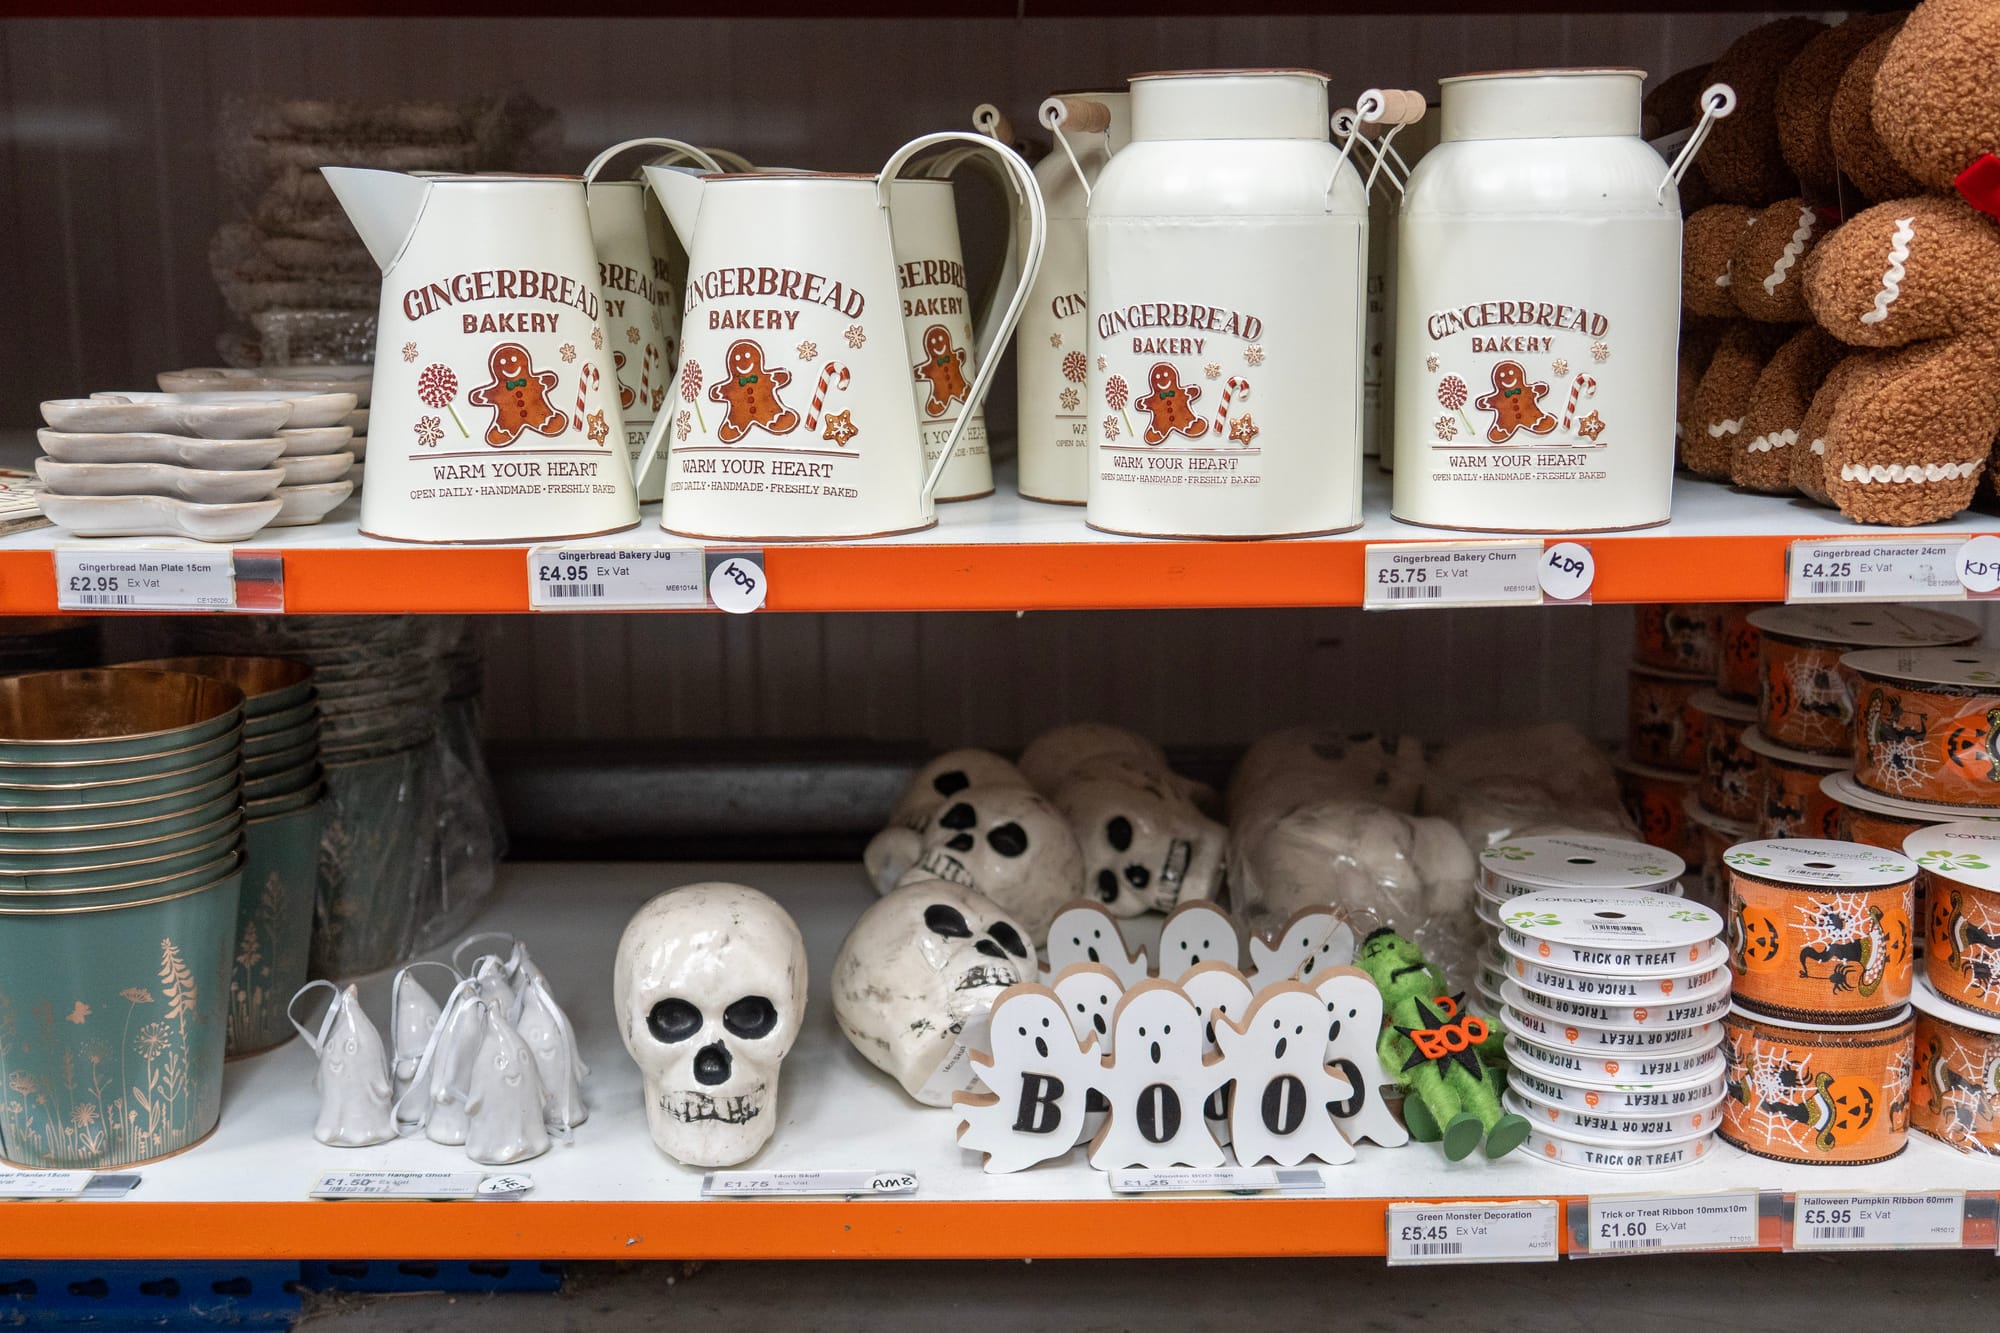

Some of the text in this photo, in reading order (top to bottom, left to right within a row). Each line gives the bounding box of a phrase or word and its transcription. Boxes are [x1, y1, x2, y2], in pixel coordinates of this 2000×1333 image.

[403, 269, 599, 321] GINGERBREAD
[462, 312, 559, 334] BAKERY
[709, 309, 800, 330] BAKERY
[1098, 303, 1262, 341] GINGERBREAD
[1427, 301, 1608, 340] GINGERBREAD
[1133, 337, 1205, 354] BAKERY
[1472, 336, 1552, 353] BAKERY
[1114, 456, 1239, 470] WARM YOUR HEART
[1449, 454, 1587, 468] WARM YOUR HEART
[434, 462, 598, 480] WARM YOUR HEART
[683, 460, 833, 478] WARM YOUR HEART
[1432, 474, 1451, 482] OPEN
[1483, 473, 1531, 481] HANDMADE
[1536, 472, 1576, 480] FRESHLY
[1579, 471, 1606, 480] BAKED
[1116, 473, 1136, 482] DAILY
[1140, 475, 1183, 484] HANDMADE
[1188, 475, 1228, 484] FRESHLY
[1231, 475, 1261, 484] BAKED
[410, 484, 616, 500] OPEN DAILY HANDMADE FRESHLY BAKED
[684, 481, 707, 491] DAILY
[711, 481, 764, 492] HANDMADE
[770, 484, 819, 495] FRESHLY
[823, 487, 858, 498] BAKED
[558, 551, 671, 562] Gingerbread Bakery Jug
[1393, 552, 1517, 564] Gingerbread Bakery Churn
[1813, 547, 1946, 559] Gingerbread Character 24cm
[78, 563, 211, 574] Gingerbread Man Plate 15cm
[539, 566, 630, 581] £4.95 Ex Vat
[1378, 568, 1468, 584] £5.75 Ex Vat
[1803, 563, 1893, 578] £4.25 Ex Vat
[70, 576, 160, 592] £2.95 Ex Vat
[1572, 950, 1676, 966] TRICK OR TREAT
[1536, 971, 1637, 996] TRICK OR TREAT
[1556, 1001, 1569, 1015] OR
[1571, 1004, 1608, 1020] TRICK
[1666, 1006, 1704, 1021] TREAT
[1410, 1015, 1489, 1060] BOO
[1600, 1028, 1694, 1046] TRICK OR TREAT
[1535, 1050, 1547, 1062] OR
[1548, 1055, 1582, 1071] TRICK
[1640, 1061, 1680, 1076] TREAT
[1683, 1058, 1695, 1070] OR
[1535, 1080, 1564, 1099] TRICK
[1625, 1085, 1713, 1106] TRICK OR TREAT
[1575, 1116, 1618, 1131] TREAT
[1622, 1120, 1638, 1132] OR
[1585, 1150, 1684, 1167] TRICK OR TREAT
[324, 1178, 369, 1186] £1.50
[872, 1177, 913, 1190] AM8
[1804, 1198, 1849, 1206] Halloween
[1851, 1197, 1890, 1206] Pumpkin
[1892, 1196, 1924, 1205] Ribbon
[1416, 1211, 1532, 1222] Green Monster Decoration
[1601, 1210, 1623, 1219] Trick
[1638, 1209, 1660, 1217] Treat
[1662, 1207, 1694, 1216] Ribbon
[1696, 1205, 1747, 1214] 10mmx10m
[1805, 1210, 1891, 1224] £5.95 Ex Vat
[1402, 1226, 1488, 1241] £5.45 Ex Vat
[1601, 1222, 1686, 1238] £1.60 Ex Vat
